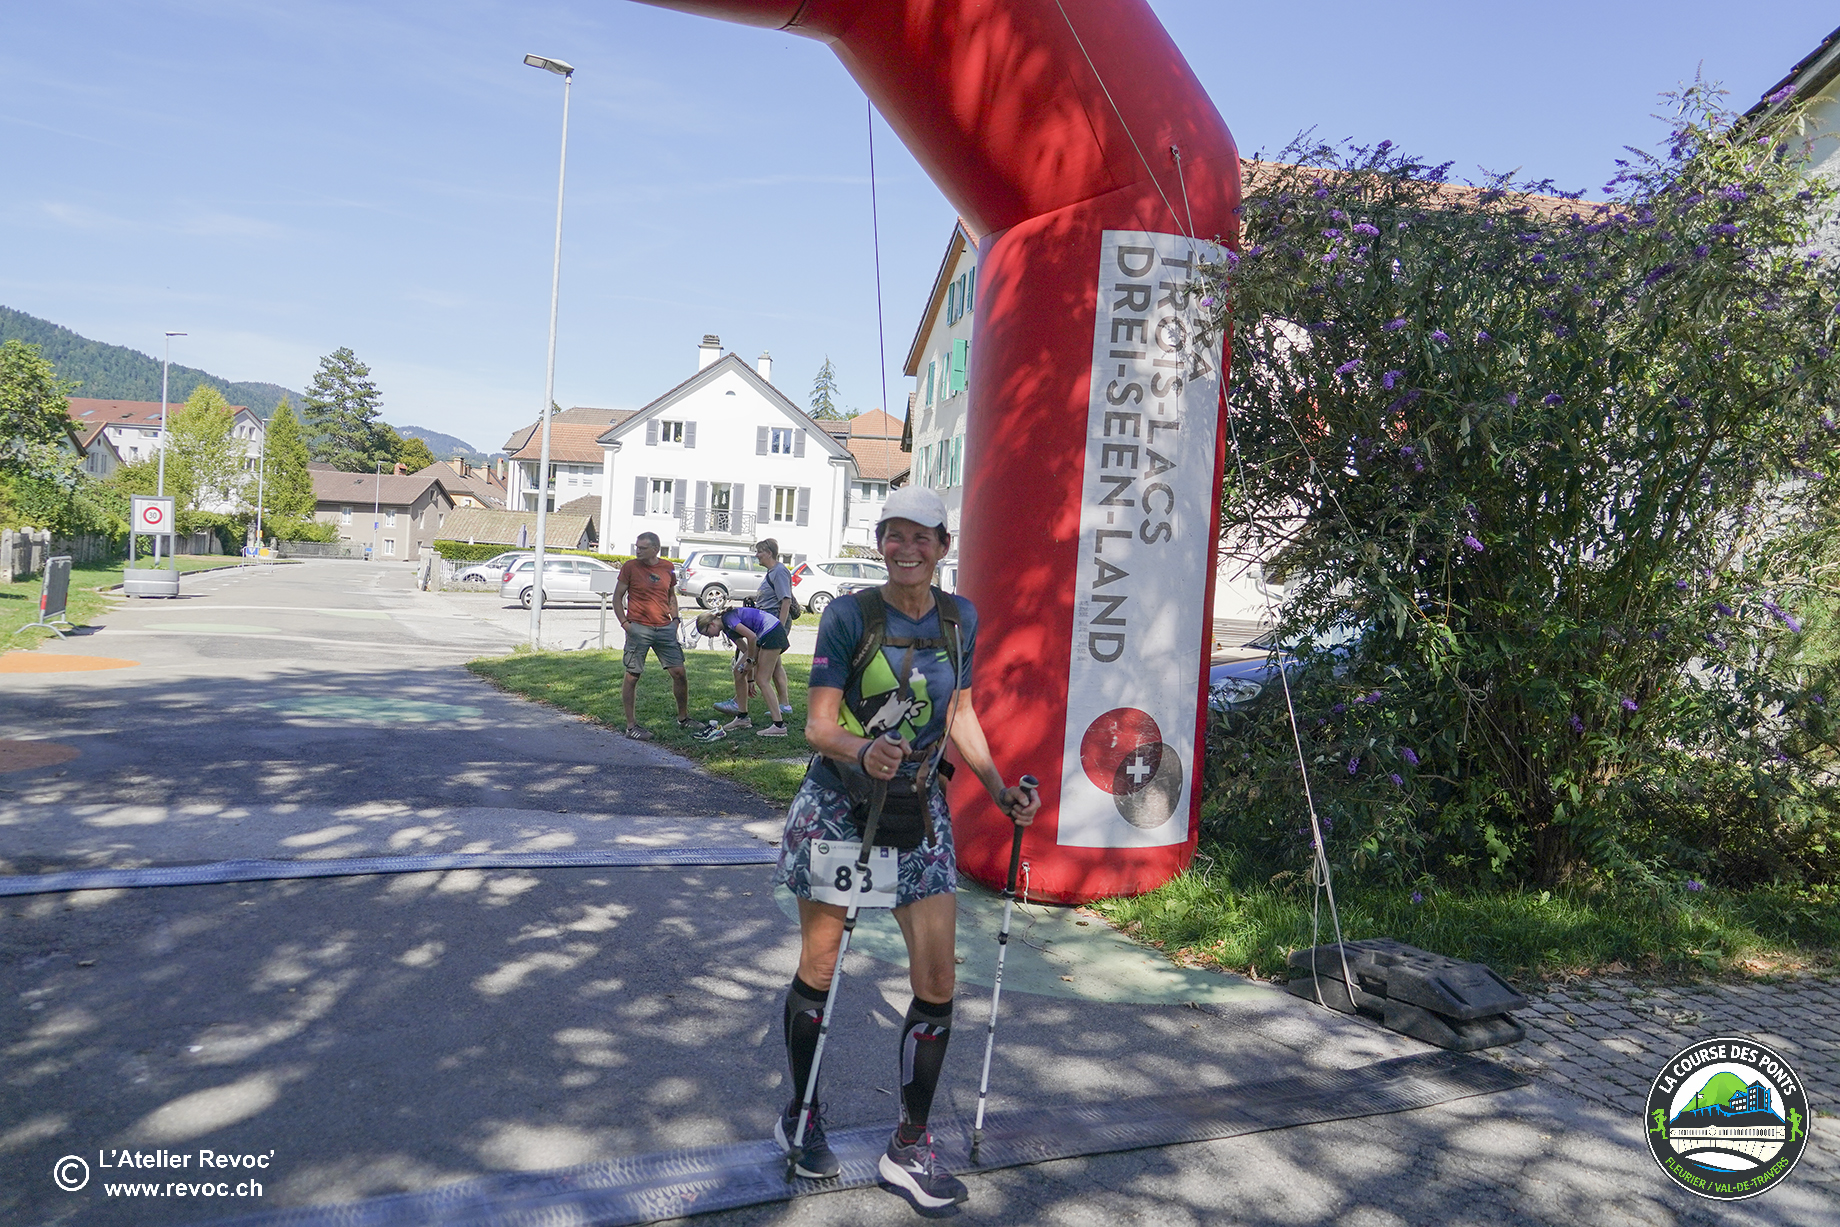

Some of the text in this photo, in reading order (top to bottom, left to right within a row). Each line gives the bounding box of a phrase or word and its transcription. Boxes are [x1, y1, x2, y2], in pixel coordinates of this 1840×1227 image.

[1088, 245, 1155, 663] DREI-SEEN-LAND
[1139, 250, 1194, 545] TROIS-LACS
[148, 511, 157, 519] 30
[834, 865, 873, 893] 83
